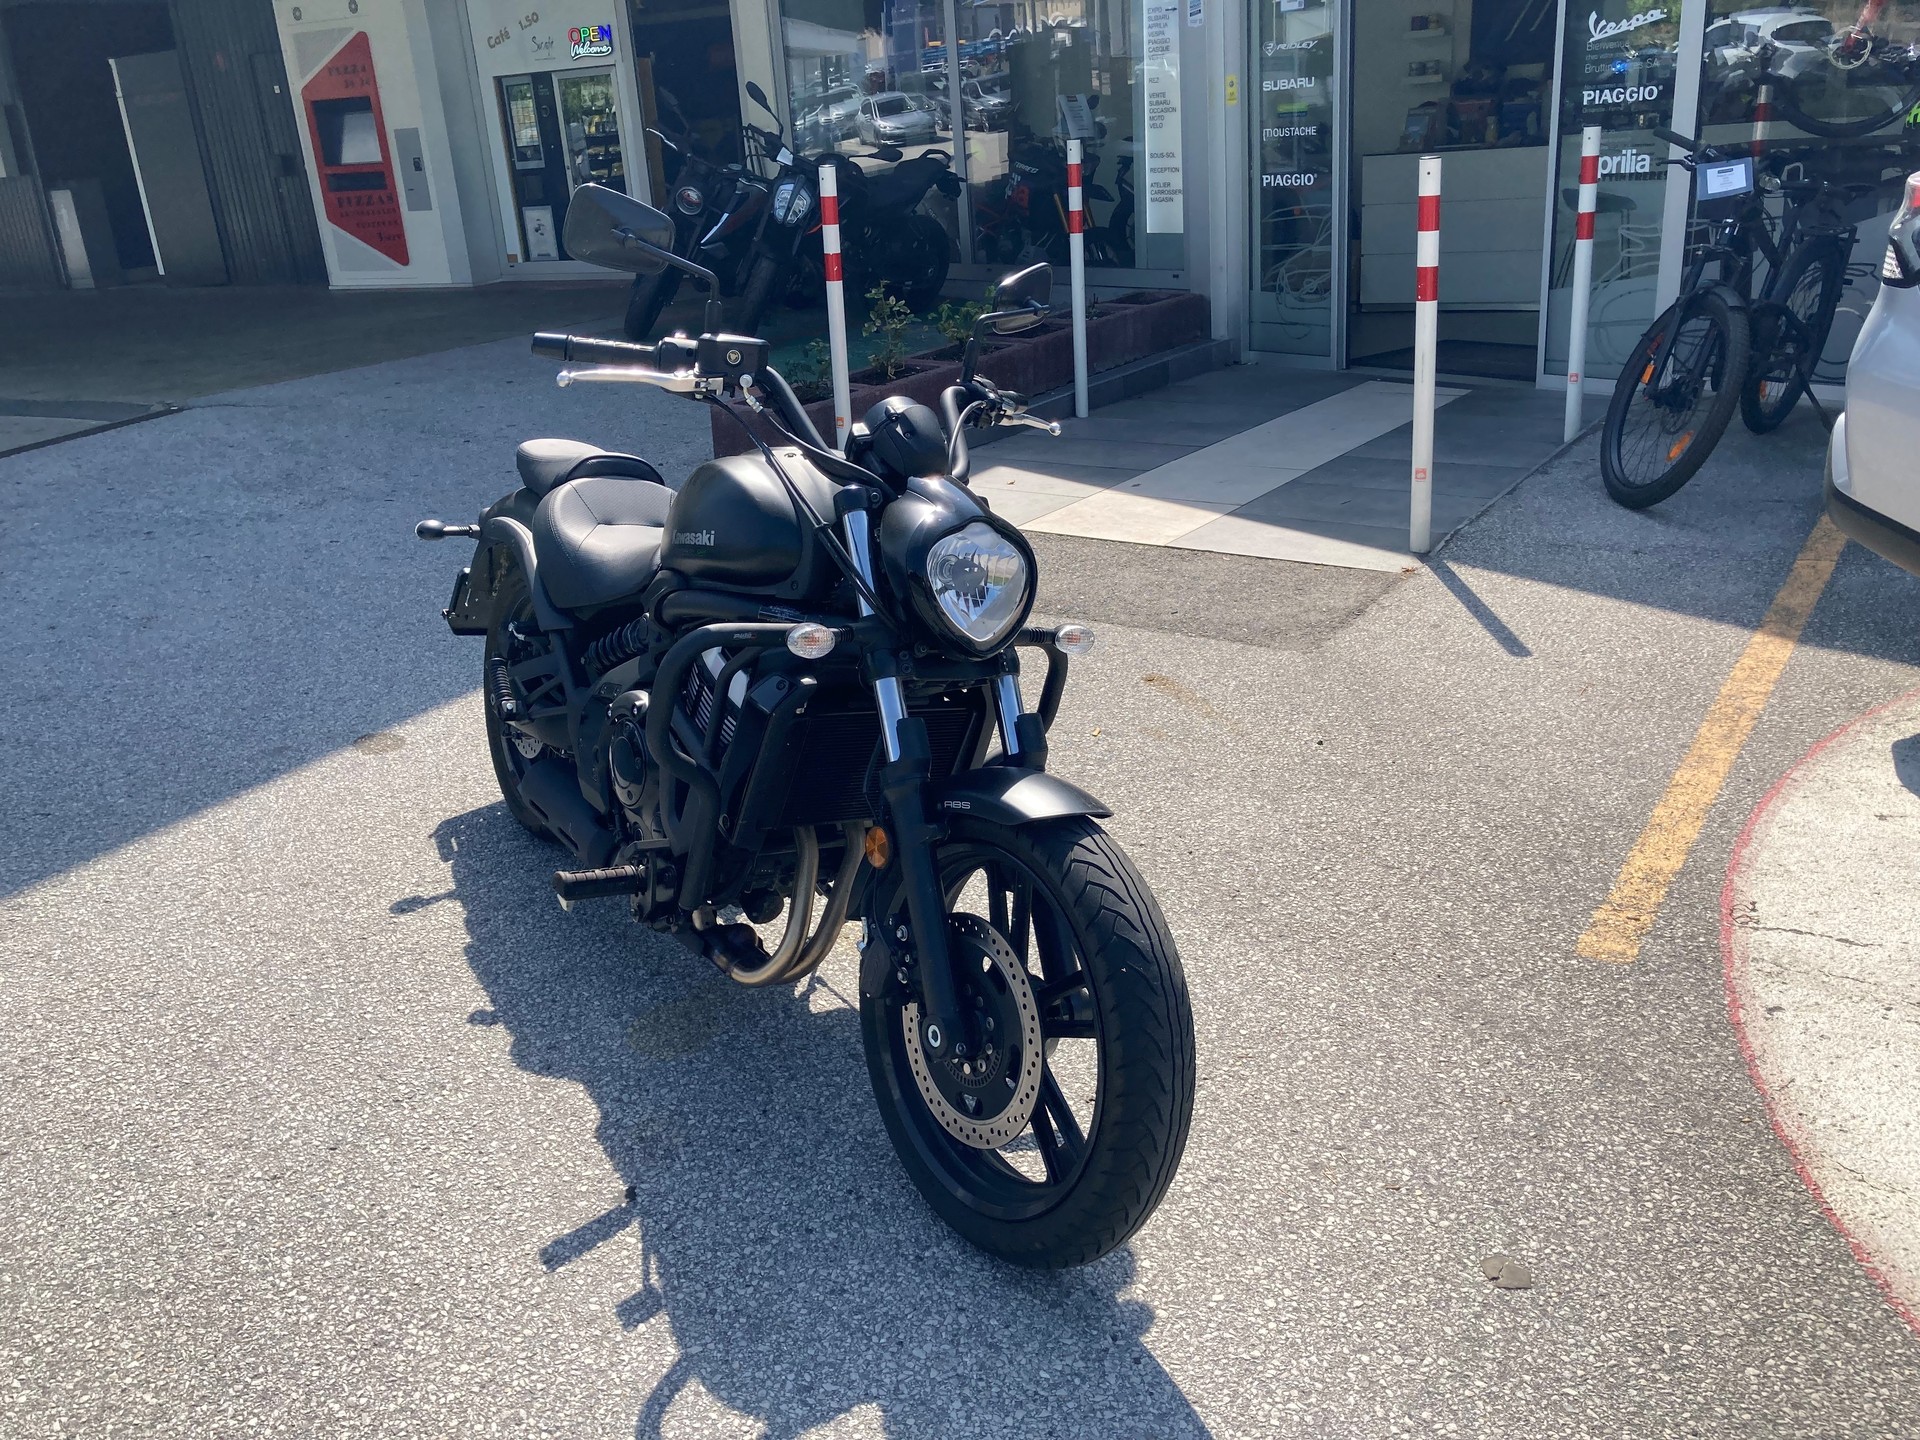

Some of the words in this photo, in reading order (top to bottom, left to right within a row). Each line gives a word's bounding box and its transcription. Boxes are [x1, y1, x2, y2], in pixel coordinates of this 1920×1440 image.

[1588, 9, 1667, 42] Vespa
[487, 26, 511, 49] Café
[567, 24, 613, 44] OPEN
[570, 42, 612, 60] Welcome
[1148, 45, 1170, 53] CASQUE
[1277, 40, 1318, 50] RIDLEY
[1263, 77, 1315, 92] SUBARU
[1582, 85, 1658, 106] PIAGGIO
[1263, 126, 1317, 141] MOUSTACHE
[1598, 149, 1651, 178] prilia
[1262, 173, 1315, 187] PIAGGIO
[337, 192, 394, 208] PIZZAS
[672, 529, 715, 546] Kawasaki
[944, 801, 971, 809] ABS
